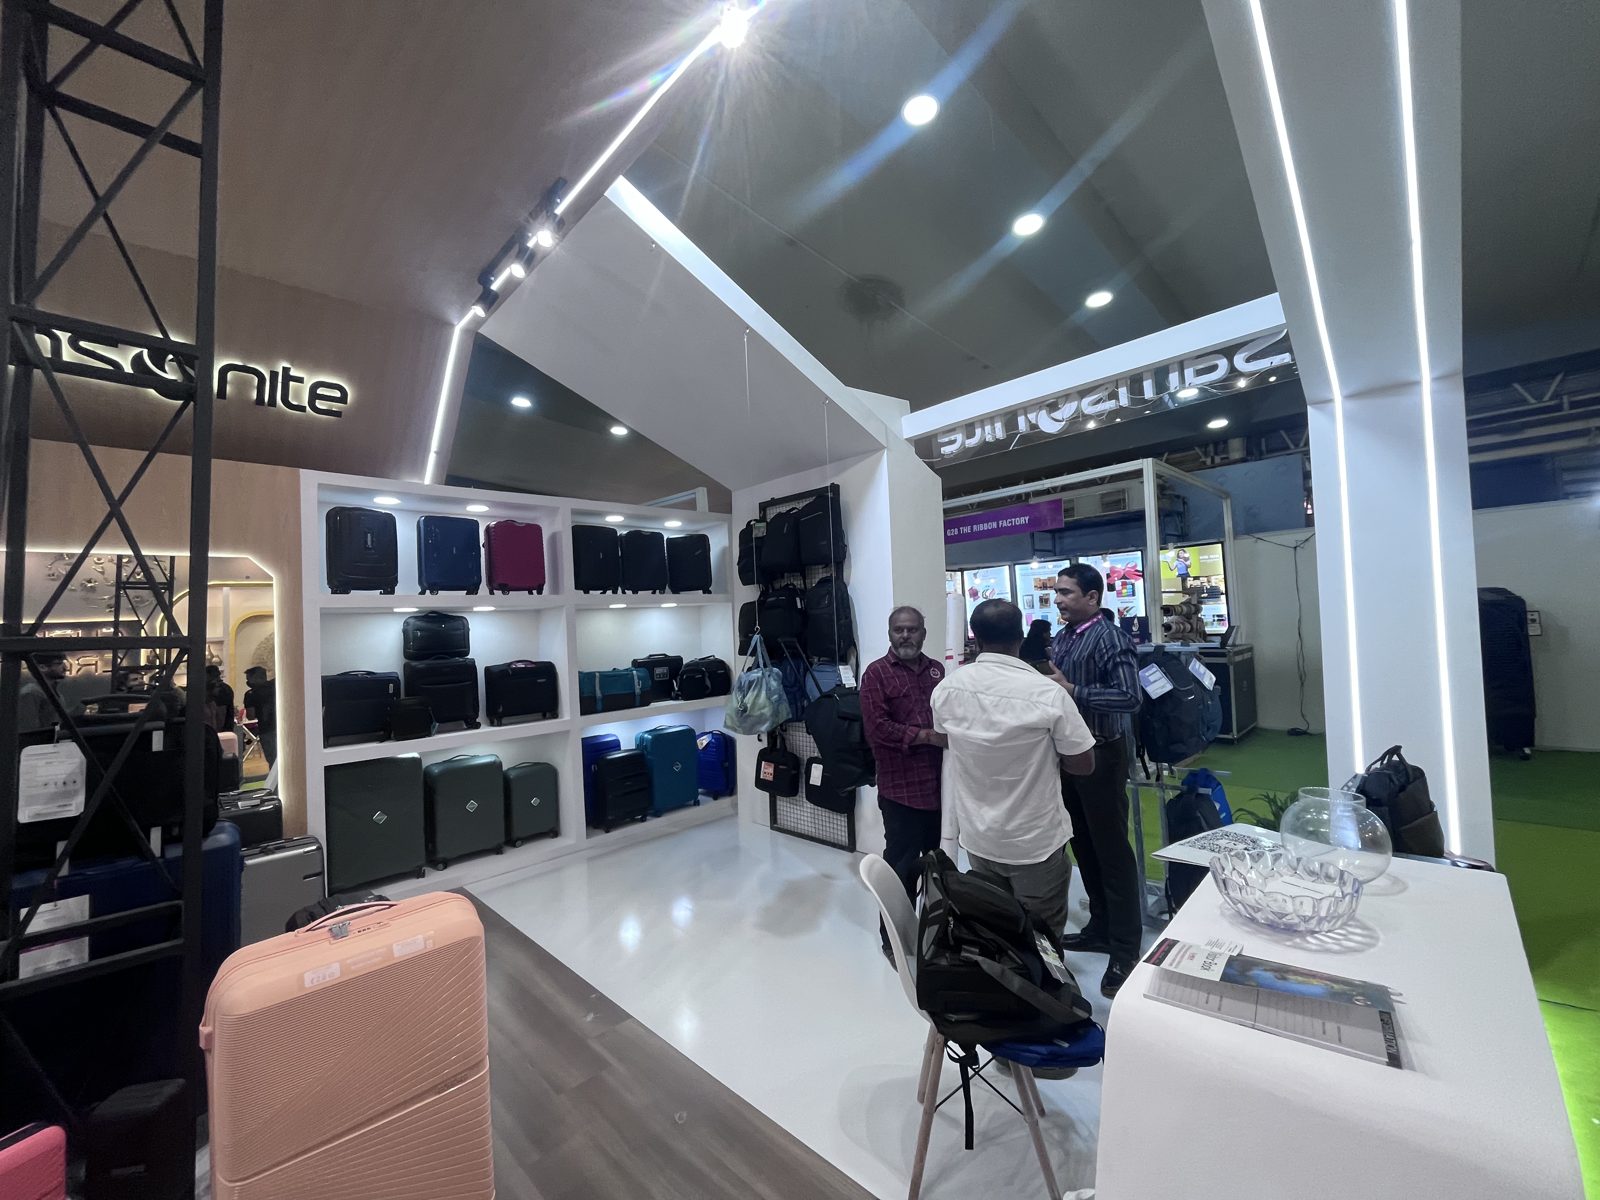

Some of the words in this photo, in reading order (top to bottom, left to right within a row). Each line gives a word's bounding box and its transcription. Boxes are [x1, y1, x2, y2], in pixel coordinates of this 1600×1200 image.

[960, 525, 972, 534] THE
[973, 522, 997, 532] RIBBON
[998, 516, 1029, 528] FACTORY
